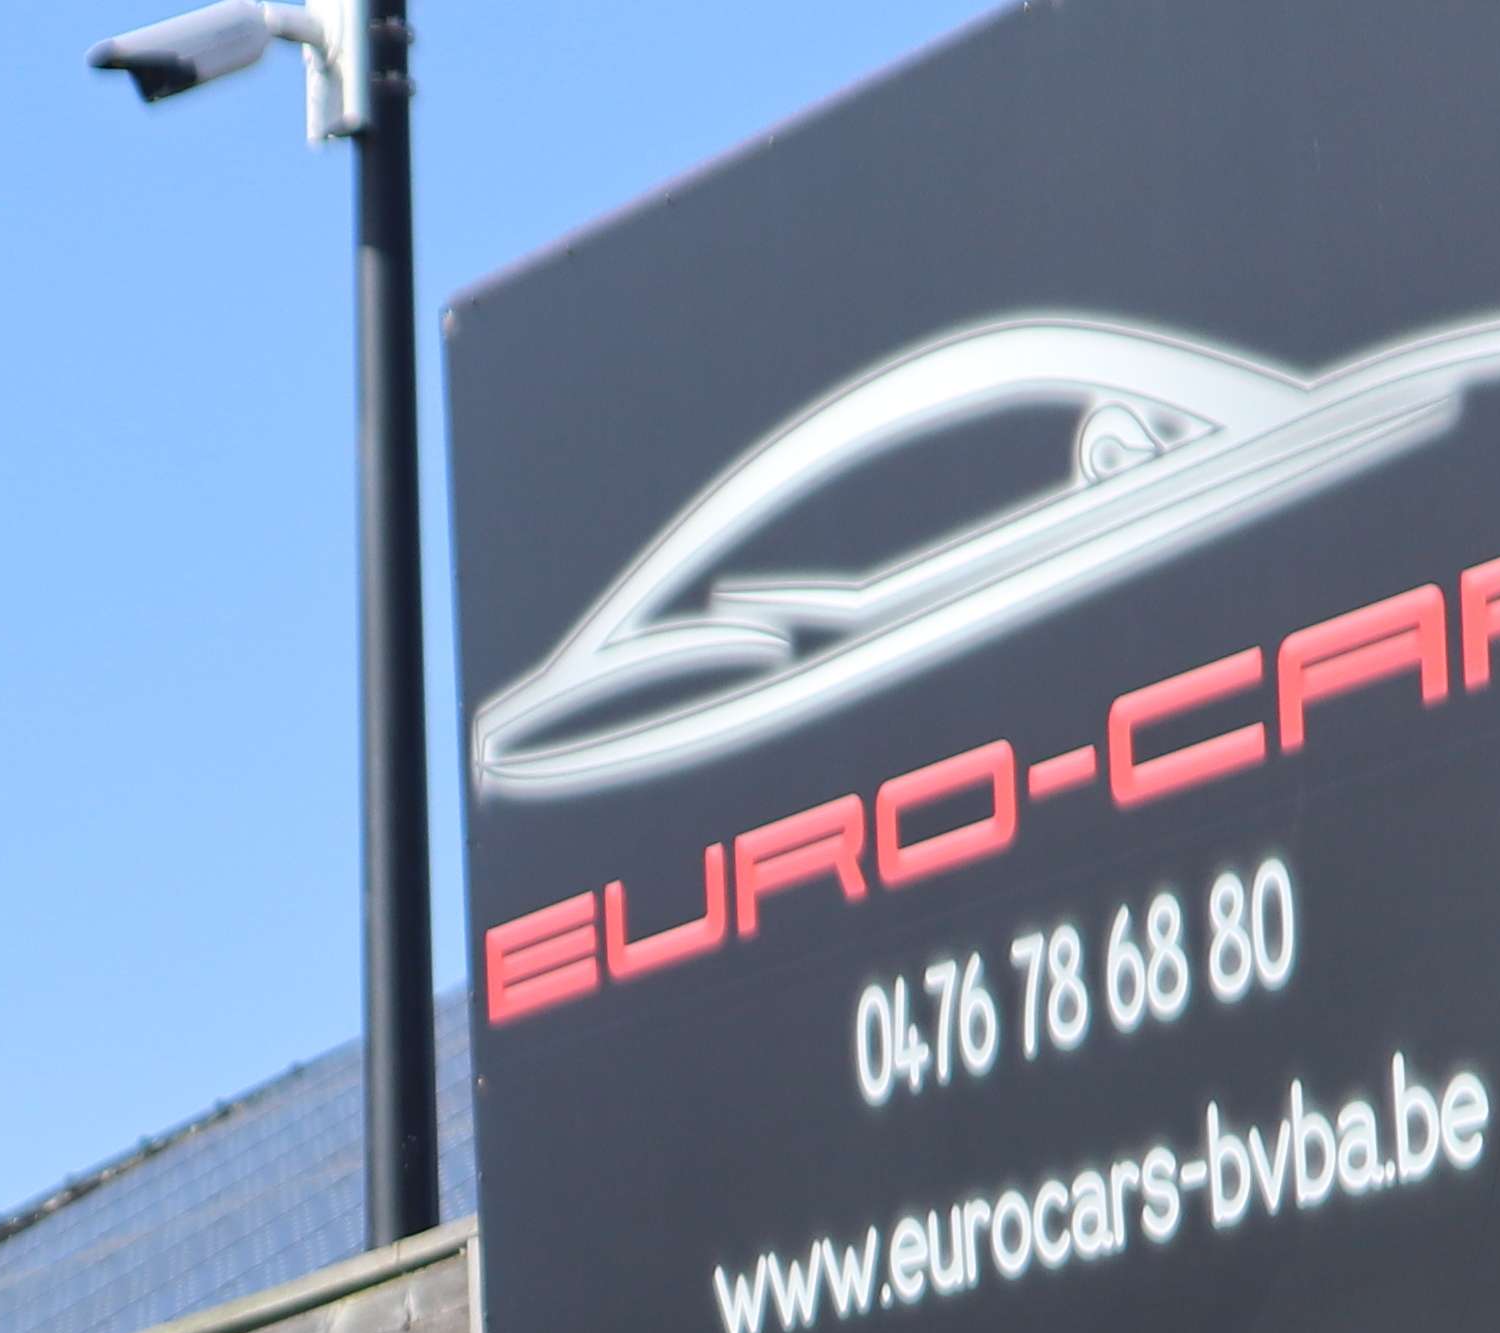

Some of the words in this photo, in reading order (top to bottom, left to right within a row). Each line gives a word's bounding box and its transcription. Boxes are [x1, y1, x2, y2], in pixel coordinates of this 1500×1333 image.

[856, 951, 1000, 1107] 0476
[1009, 923, 1090, 1061] 78
[1106, 891, 1190, 1034] 68
[1208, 857, 1295, 1001] 80
